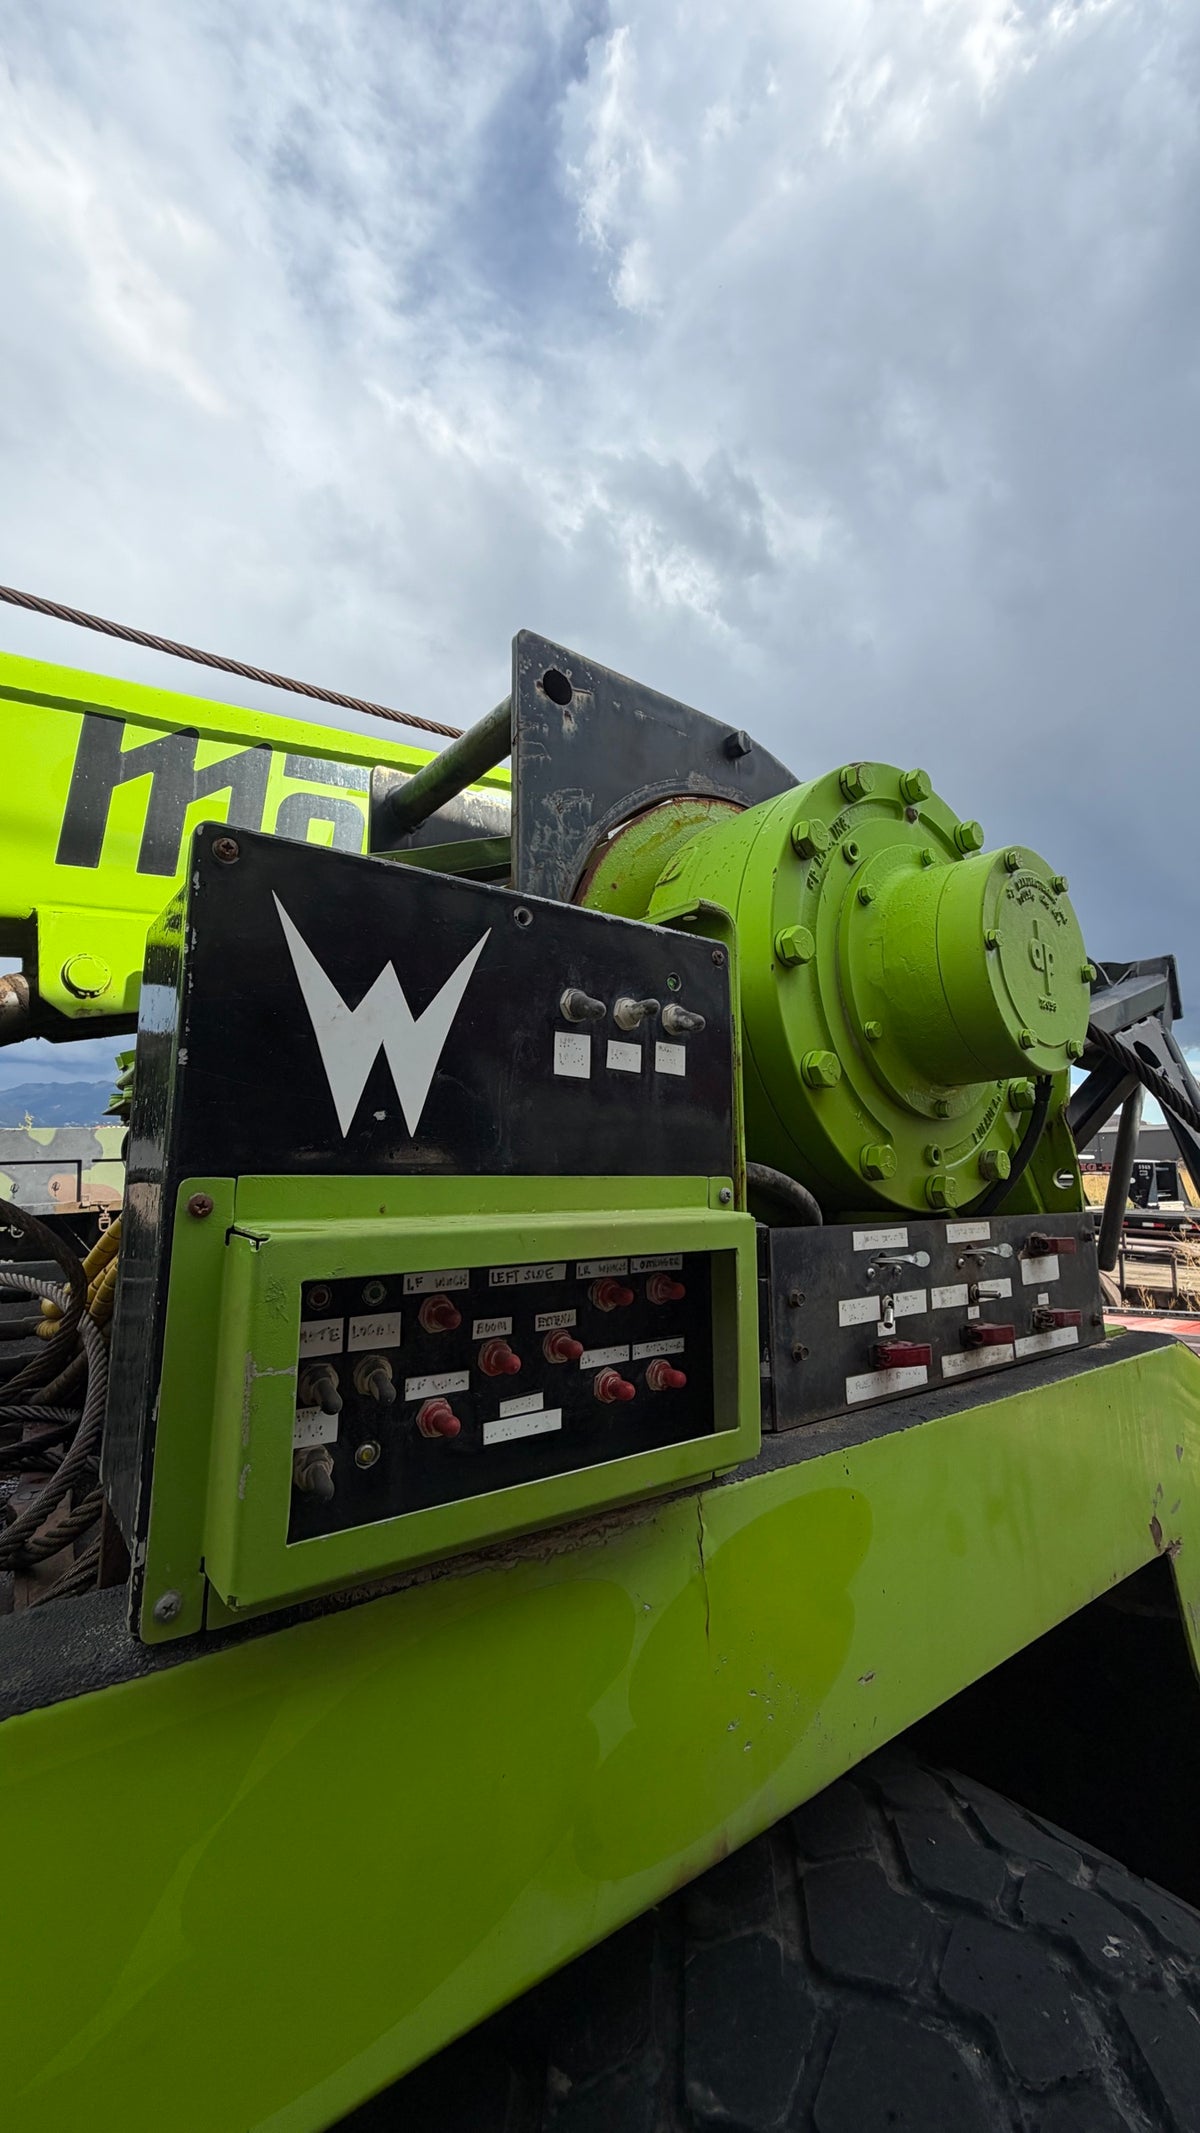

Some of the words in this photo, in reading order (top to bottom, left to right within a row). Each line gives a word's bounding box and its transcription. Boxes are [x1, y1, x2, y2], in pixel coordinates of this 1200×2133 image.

[406, 1276, 424, 1291] LF
[491, 1269, 520, 1285] LEFT
[524, 1267, 554, 1281] SIDE
[476, 1320, 507, 1335] BOOM
